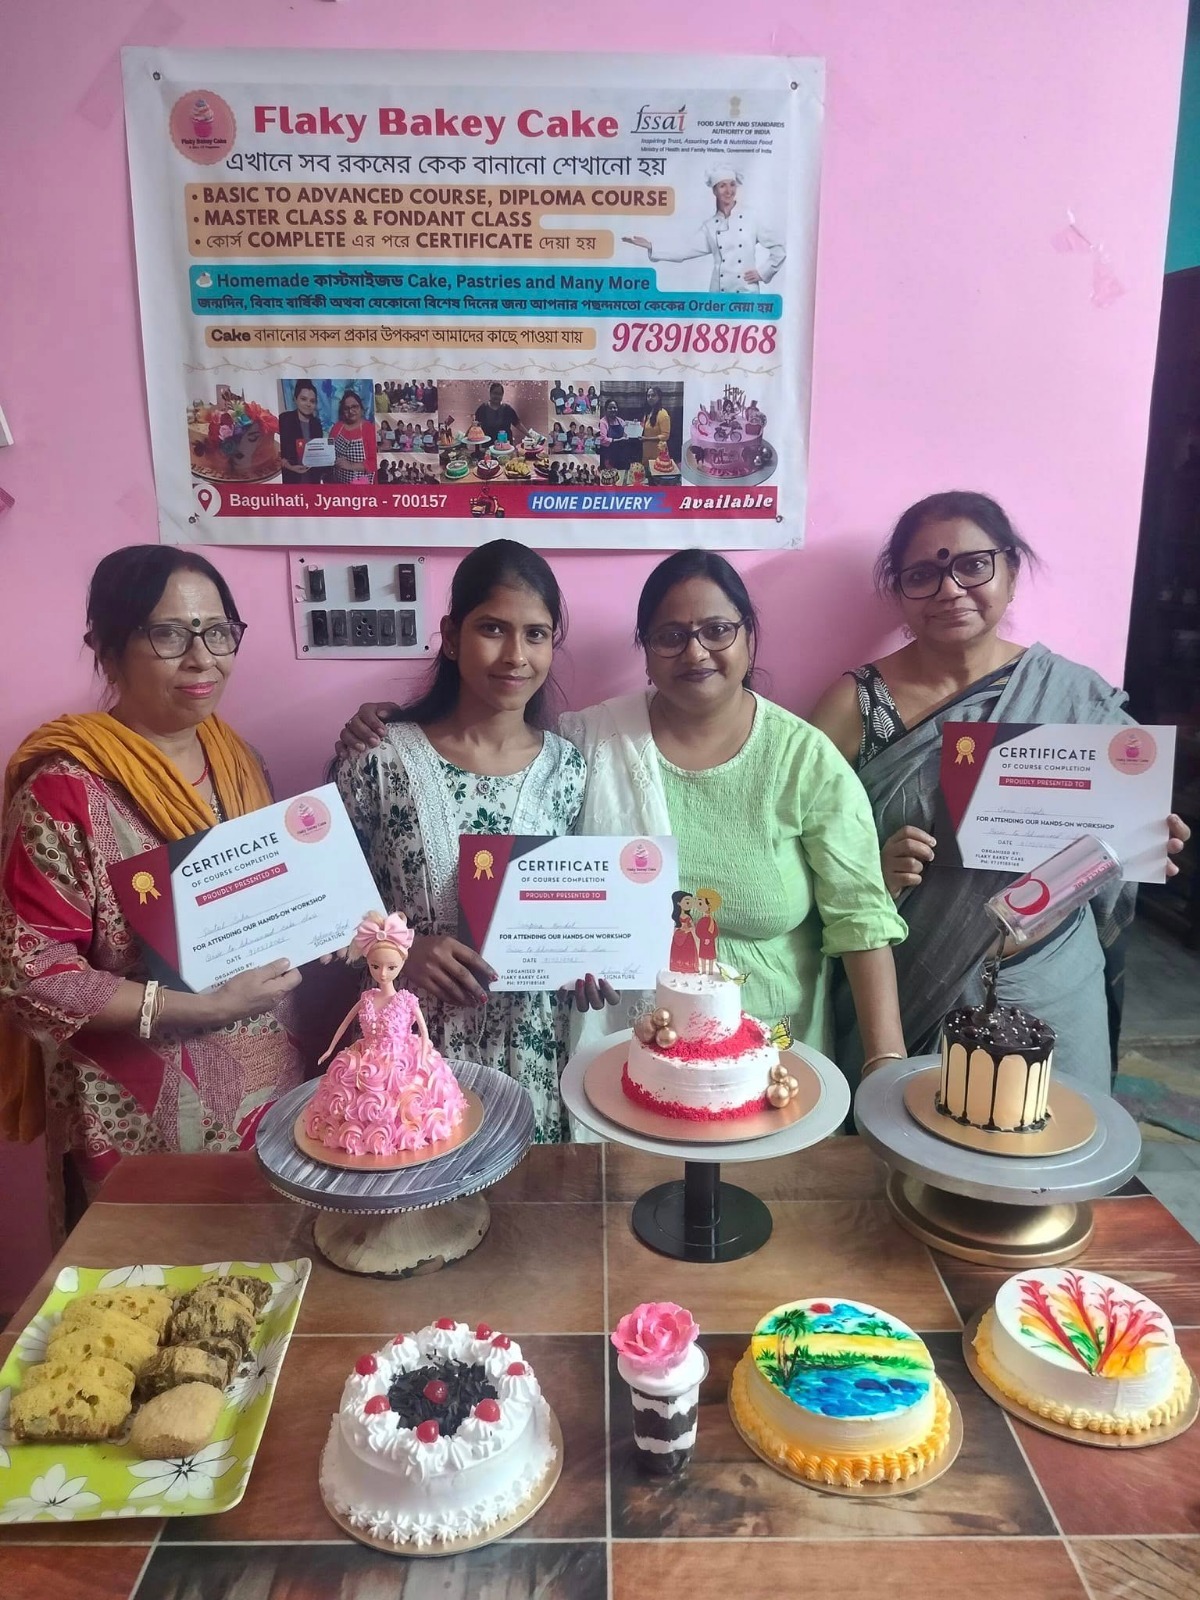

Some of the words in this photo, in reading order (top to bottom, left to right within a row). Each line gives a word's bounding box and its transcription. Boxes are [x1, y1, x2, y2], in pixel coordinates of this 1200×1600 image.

[254, 106, 367, 143] Flaky
[379, 107, 506, 145] Bakey
[517, 109, 619, 138] Cake
[631, 104, 687, 133] fssai
[226, 151, 292, 173] এখানে
[298, 153, 331, 173] সব
[337, 154, 411, 174] রকমের
[418, 155, 466, 174] কেক
[474, 155, 546, 175] বানানো
[552, 155, 632, 176] শেখানো
[637, 156, 667, 176] হয়
[203, 187, 259, 203] BASIC
[265, 187, 291, 203] TO
[297, 187, 404, 204] ADVANCED
[410, 188, 493, 207] COURSE,
[500, 189, 586, 206] DIPLOMA
[592, 190, 668, 207] COURSE
[205, 210, 280, 226] MASTER
[286, 209, 347, 226] CLASS
[353, 211, 368, 226] &
[374, 210, 466, 226] FONDANT
[471, 211, 532, 228] CLASS
[206, 230, 244, 248] কোর্স
[248, 232, 346, 248] COMPLETE
[352, 234, 375, 248] এর
[381, 234, 410, 248] পরে
[416, 232, 533, 249] CERTIFICATE
[539, 236, 572, 250] দেয়া
[577, 238, 596, 250] হয়
[218, 274, 310, 288] Homemade
[408, 274, 452, 291] Cake,
[457, 274, 522, 289] Pastries
[526, 274, 555, 289] and
[561, 275, 604, 293] Many
[609, 276, 650, 290] More
[251, 295, 284, 309] বিবাহ
[330, 297, 365, 308] অথবা
[424, 295, 461, 309] বিশেষ
[464, 294, 498, 310] দিনের
[502, 298, 526, 310] জন্য
[530, 298, 578, 310] আপনার
[644, 300, 685, 312] কেকের
[689, 300, 725, 312] Order
[211, 328, 251, 342] Cake
[254, 328, 307, 342] বানানোর
[309, 329, 341, 341] সকল
[344, 329, 378, 342] প্রকার
[380, 325, 430, 342] উপকরণ
[432, 330, 484, 343] আমাদের
[487, 330, 518, 344] কাছে
[520, 330, 559, 344] পাওয়া
[561, 330, 584, 344] যায়
[612, 322, 777, 354] 9739188168
[230, 494, 309, 510] Baguihati,
[314, 494, 378, 511] Jyangra
[392, 494, 448, 508] 700157
[532, 496, 578, 510] HOME
[582, 496, 653, 511] DELIVERY
[680, 494, 773, 511] Available
[1000, 747, 1096, 761] CERTIFICATE
[1006, 778, 1035, 786] PROUDLY
[1037, 779, 1074, 788] PRESENTED
[1076, 822, 1114, 830] WORKSHOP
[181, 832, 280, 878] CERTIFICATE
[192, 880, 202, 888] OF
[204, 866, 232, 884] COURSE
[235, 850, 280, 874] COMPLETION
[518, 860, 609, 872] CERTIFICATE
[203, 887, 233, 902] PROUDLY
[235, 872, 270, 889] PRESENTED
[526, 892, 554, 900] PROUDLY
[556, 892, 590, 900] PRESENTED
[192, 942, 206, 952] FOR
[208, 928, 242, 946] ATTENDING
[242, 922, 257, 932] OUR
[258, 910, 290, 928] HANDS-ON
[291, 894, 326, 912] WORKSHOP
[314, 931, 346, 948] SIGNATURE
[226, 954, 242, 965] DATE
